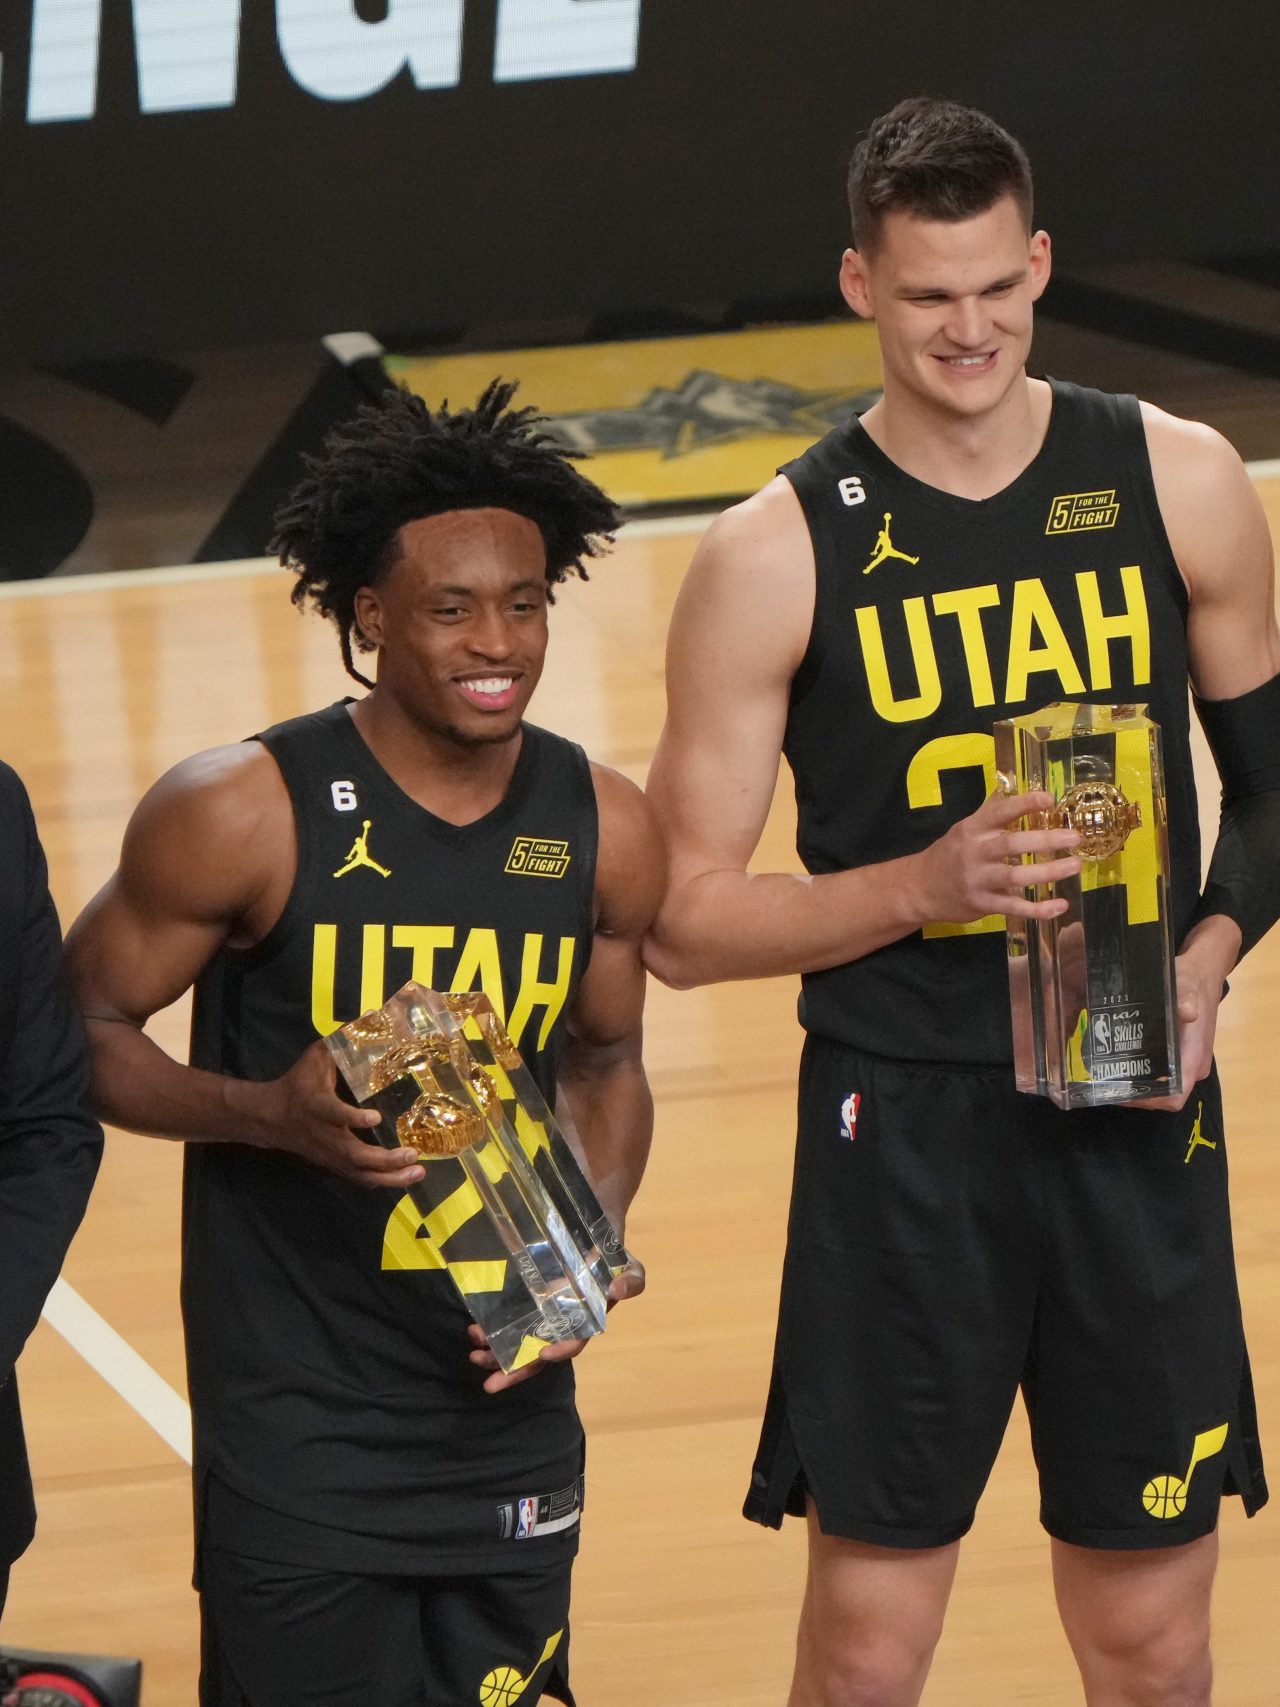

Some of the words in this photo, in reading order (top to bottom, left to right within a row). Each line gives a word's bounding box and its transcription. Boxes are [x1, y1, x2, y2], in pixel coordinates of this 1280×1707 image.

[836, 476, 867, 506] 6
[1079, 498, 1093, 507] FOR
[1094, 496, 1109, 505] THE
[1053, 501, 1071, 529] 5
[1073, 510, 1113, 527] FIGHT
[855, 565, 1151, 723] UTAH
[330, 780, 358, 812] 6
[511, 842, 530, 869] 5
[534, 844, 549, 853] FOR
[549, 846, 562, 854] THE
[527, 858, 564, 873] FIGHT
[1114, 1022, 1144, 1043] SKILLS
[1090, 1058, 1152, 1081] CHAMPIONS
